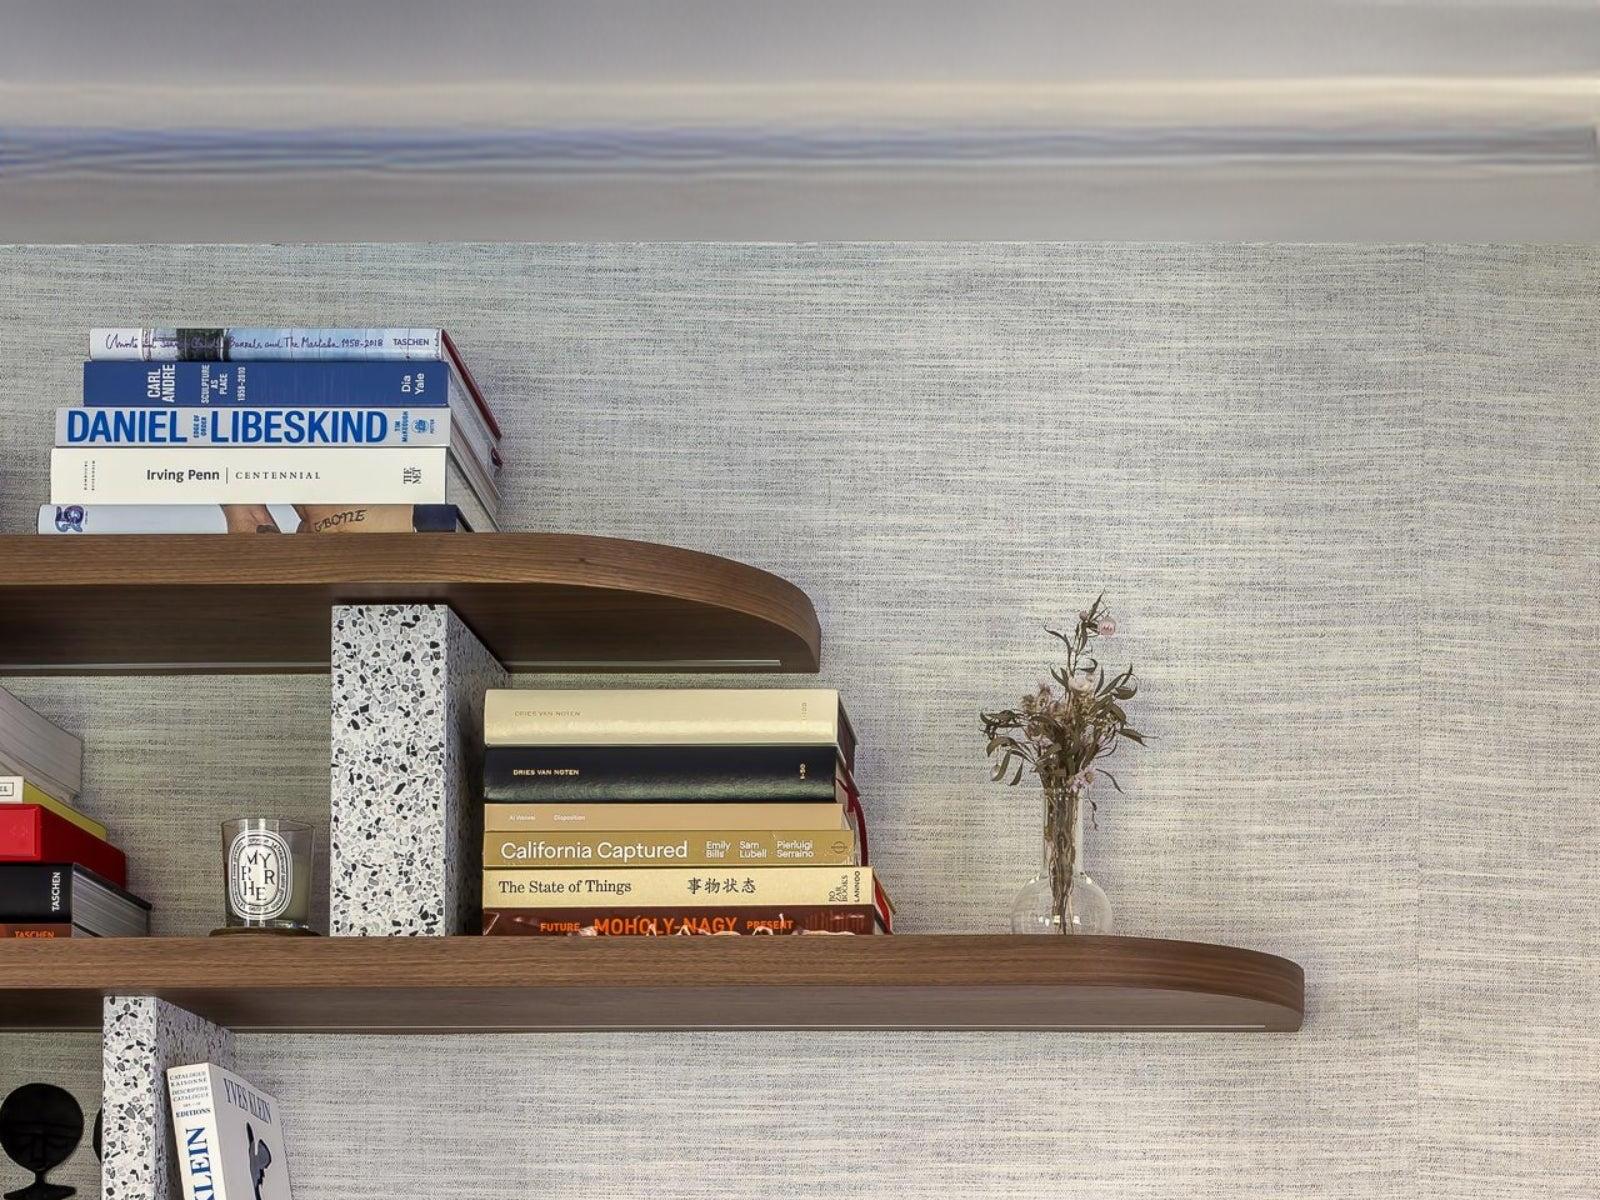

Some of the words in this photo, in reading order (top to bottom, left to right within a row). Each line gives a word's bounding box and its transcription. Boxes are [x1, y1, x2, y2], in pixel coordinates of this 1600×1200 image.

[341, 338, 384, 348] 1958-2018
[393, 338, 429, 346] TASCHEN
[147, 368, 161, 398] CARL
[162, 364, 176, 403] ANDRE
[201, 364, 210, 403] SCULPTURE
[210, 379, 218, 389] AS
[219, 373, 228, 395] PLACE
[401, 375, 411, 393] Dia
[415, 372, 425, 395] Yale
[67, 411, 188, 442] DANIEL
[211, 411, 388, 443] LIBESKIND
[147, 469, 184, 483] Irving
[188, 469, 220, 480] Penn
[235, 471, 320, 480] CENTENNIAL
[500, 841, 592, 860] California
[597, 841, 689, 863] Captured
[706, 841, 731, 851] Emily
[739, 841, 760, 850] Sam
[706, 849, 725, 858] Bills
[739, 849, 767, 858] Lubell
[51, 871, 61, 912] TASCHEN
[498, 880, 525, 893] The
[529, 880, 565, 893] State
[568, 880, 583, 892] of
[585, 880, 632, 895] Things
[687, 877, 757, 895] 事物状态
[540, 922, 581, 932] FUTURE
[594, 917, 737, 935] MOHOLY-NAGY
[747, 920, 794, 930] PRESENT
[15, 931, 55, 939] TASCHEN
[223, 1078, 249, 1111] YVES
[248, 1091, 272, 1124] KLEIN
[175, 1107, 211, 1118] EDITIONS
